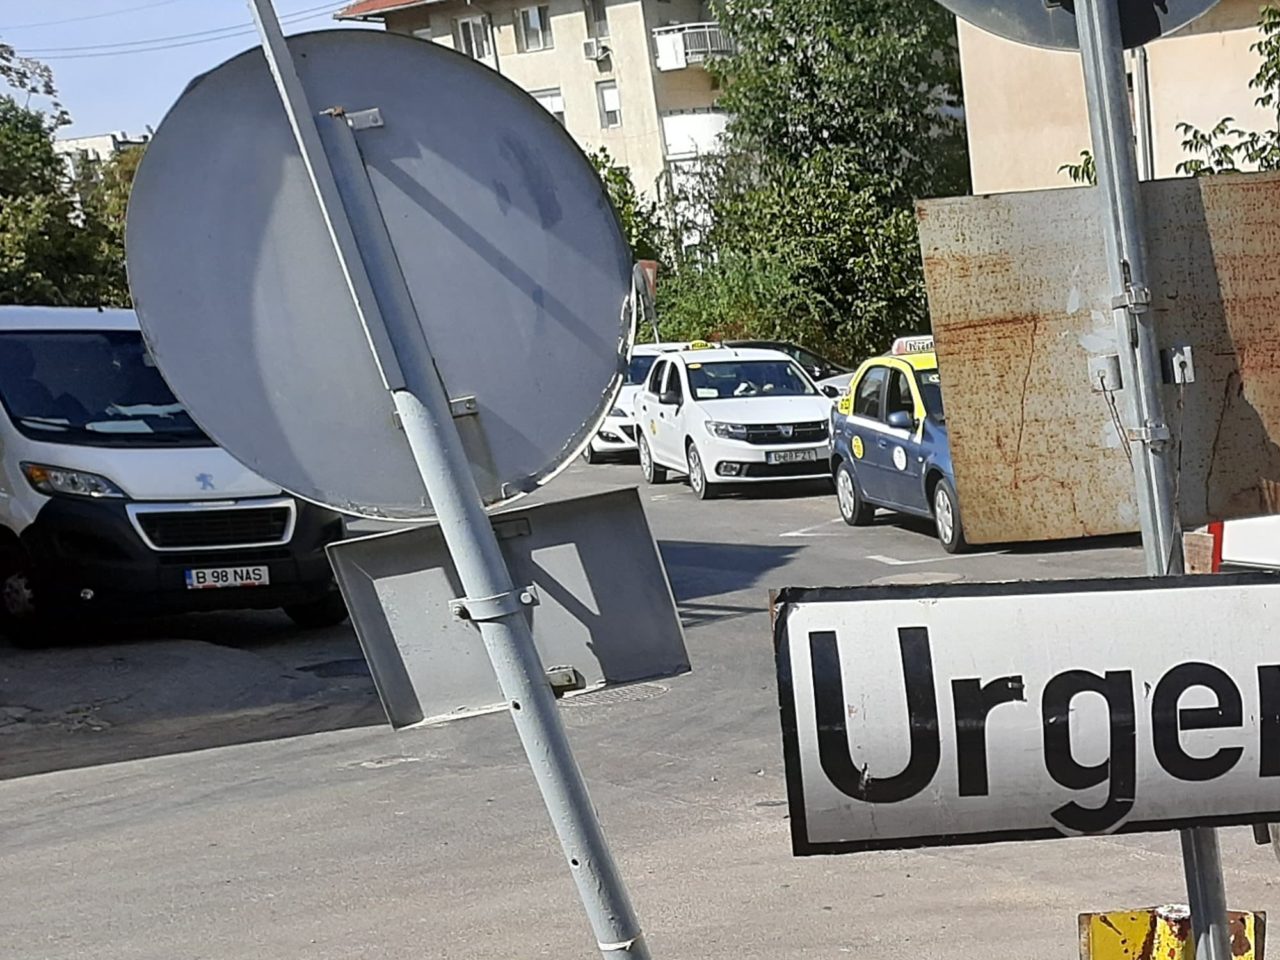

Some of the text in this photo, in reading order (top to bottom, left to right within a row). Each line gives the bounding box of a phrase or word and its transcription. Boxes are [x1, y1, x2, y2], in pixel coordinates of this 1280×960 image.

[195, 567, 263, 584] B 98 NAS
